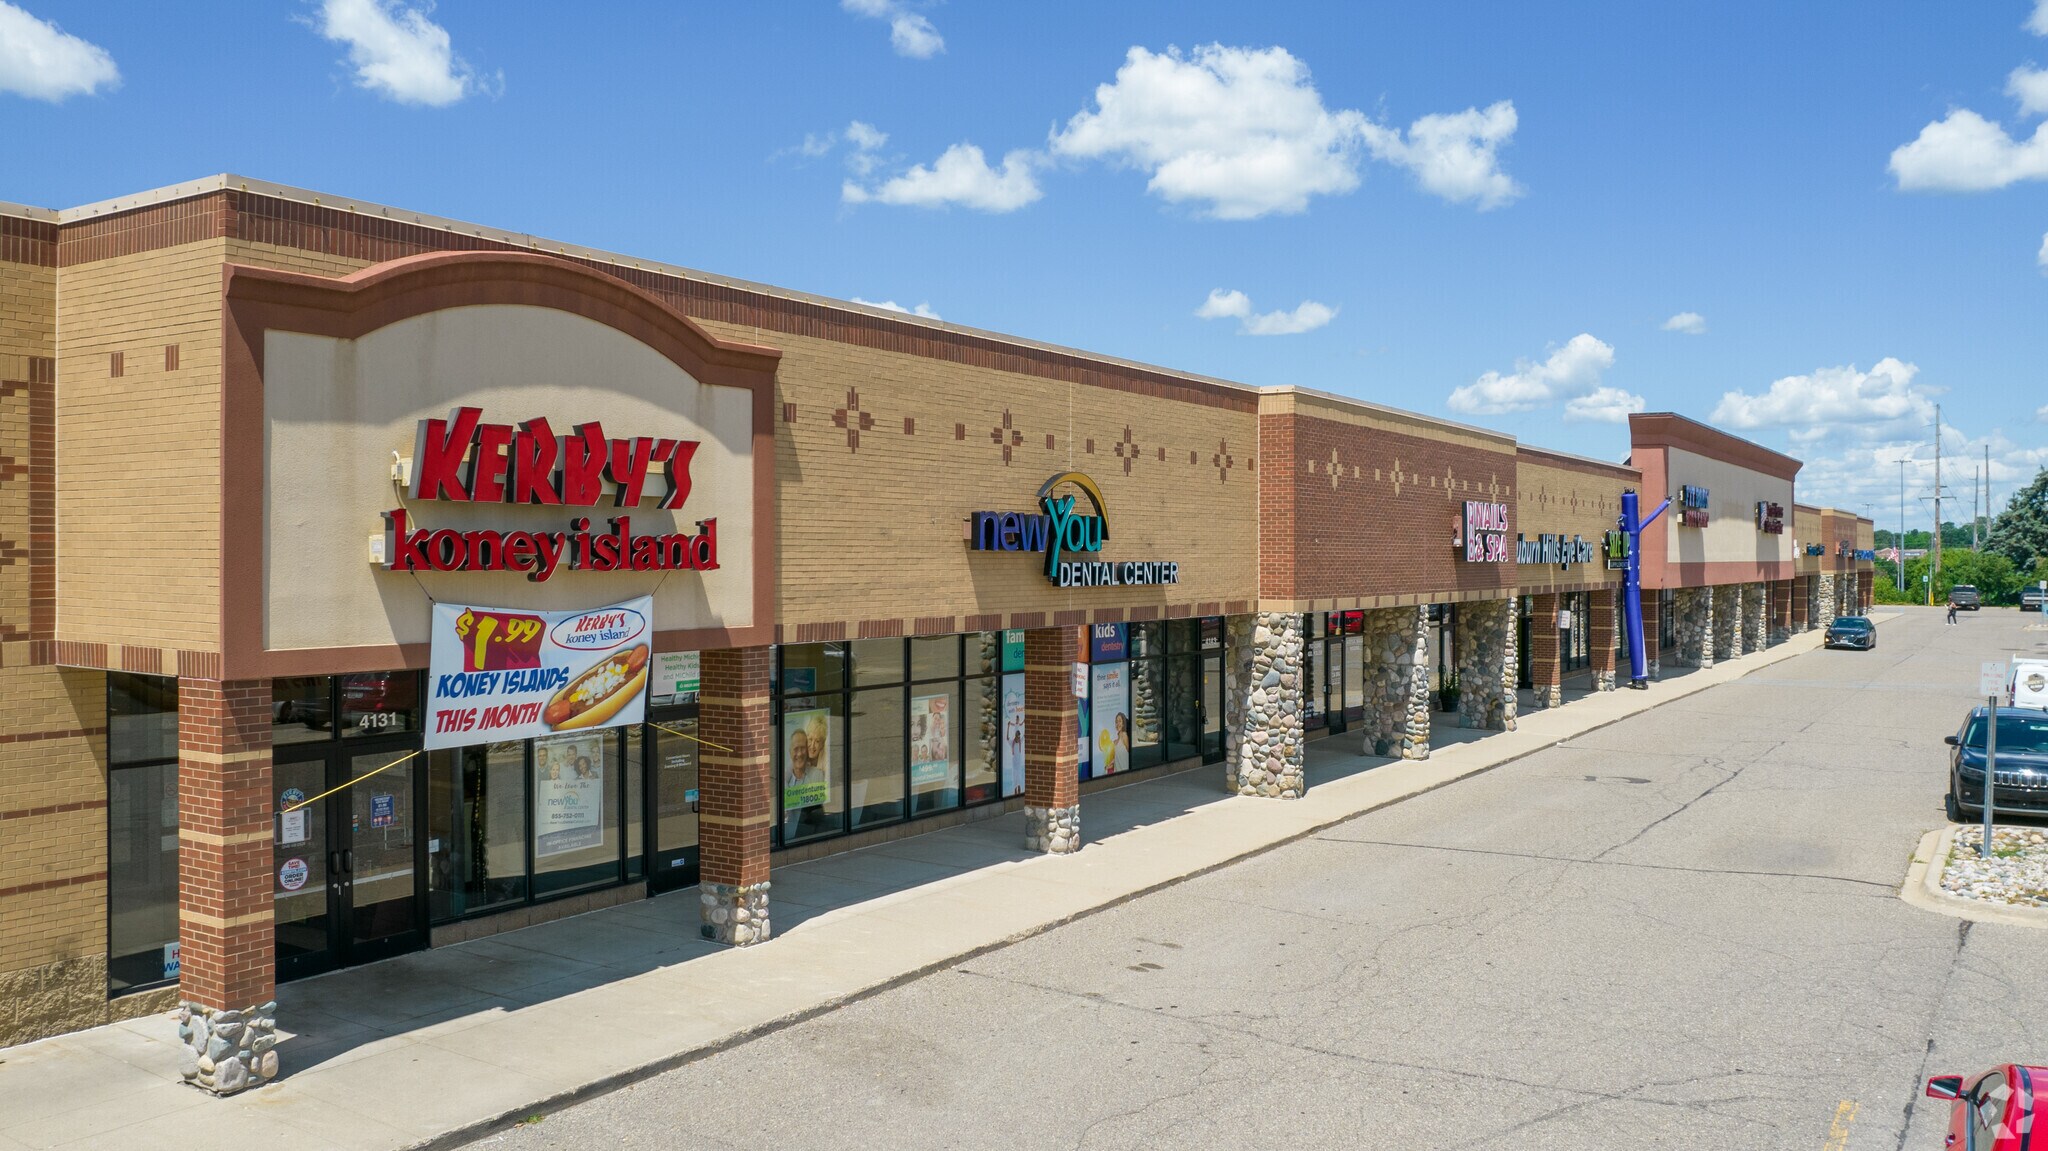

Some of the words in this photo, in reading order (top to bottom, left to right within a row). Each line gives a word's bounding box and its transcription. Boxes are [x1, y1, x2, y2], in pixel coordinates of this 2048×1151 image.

[409, 407, 700, 509] KERBY'S
[1475, 502, 1508, 532] NAILS
[382, 508, 565, 582] koney
[569, 516, 720, 571] island
[1475, 534, 1484, 562] &
[1486, 534, 1508, 562] SPA
[1516, 533, 1540, 564] uburn
[1542, 534, 1560, 564] Hills
[1560, 534, 1576, 571] Eye
[1576, 535, 1593, 563] Care
[1060, 562, 1120, 588] DENTAL
[1122, 561, 1178, 584] CENTER
[566, 632, 597, 644] koney
[600, 627, 631, 641] island
[575, 612, 626, 632] KERBY'S
[1096, 623, 1115, 638] kids
[456, 607, 542, 671] $1.99
[1006, 630, 1024, 644] fam
[436, 671, 502, 698] KONEY
[501, 666, 570, 694] ISLANDS
[360, 712, 396, 728] 4131
[436, 708, 478, 734] THIS
[478, 702, 543, 731] MONTH
[786, 785, 826, 798] Overdentures
